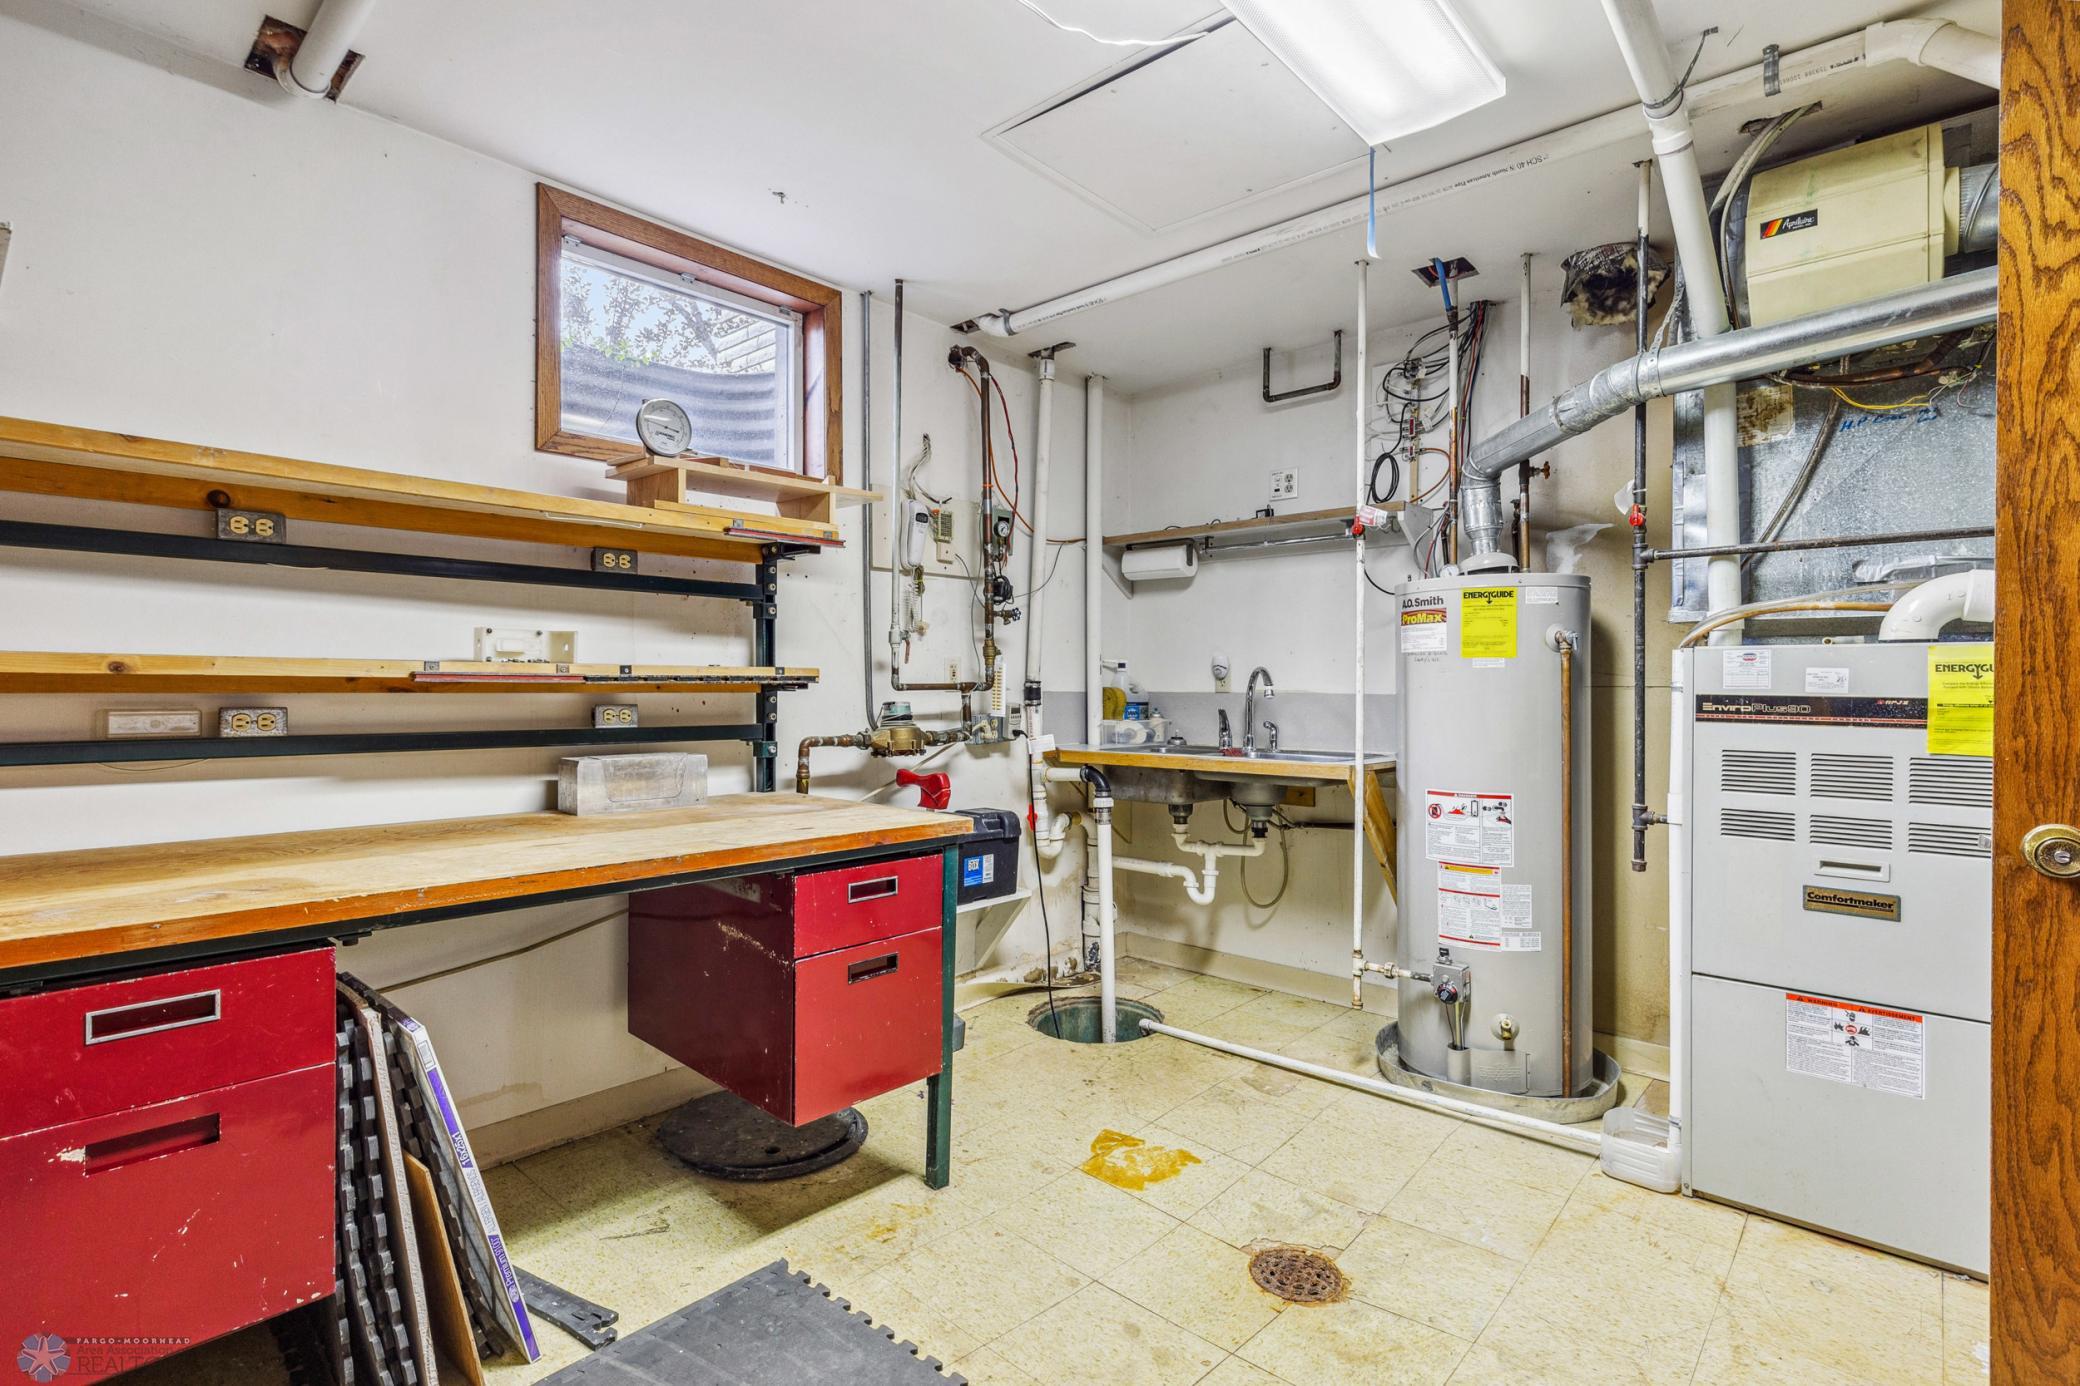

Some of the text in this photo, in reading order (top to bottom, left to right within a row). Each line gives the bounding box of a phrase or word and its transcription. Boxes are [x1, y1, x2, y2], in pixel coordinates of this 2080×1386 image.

[1515, 160, 1527, 170] 40
[1526, 154, 1543, 167] SCH
[1463, 590, 1514, 602] ENERGYGUIDE
[1402, 612, 1443, 625] ProMax
[1807, 891, 1894, 910] Comfortmaker
[450, 1130, 473, 1167] 16x25x1
[495, 1252, 515, 1287] Premium
